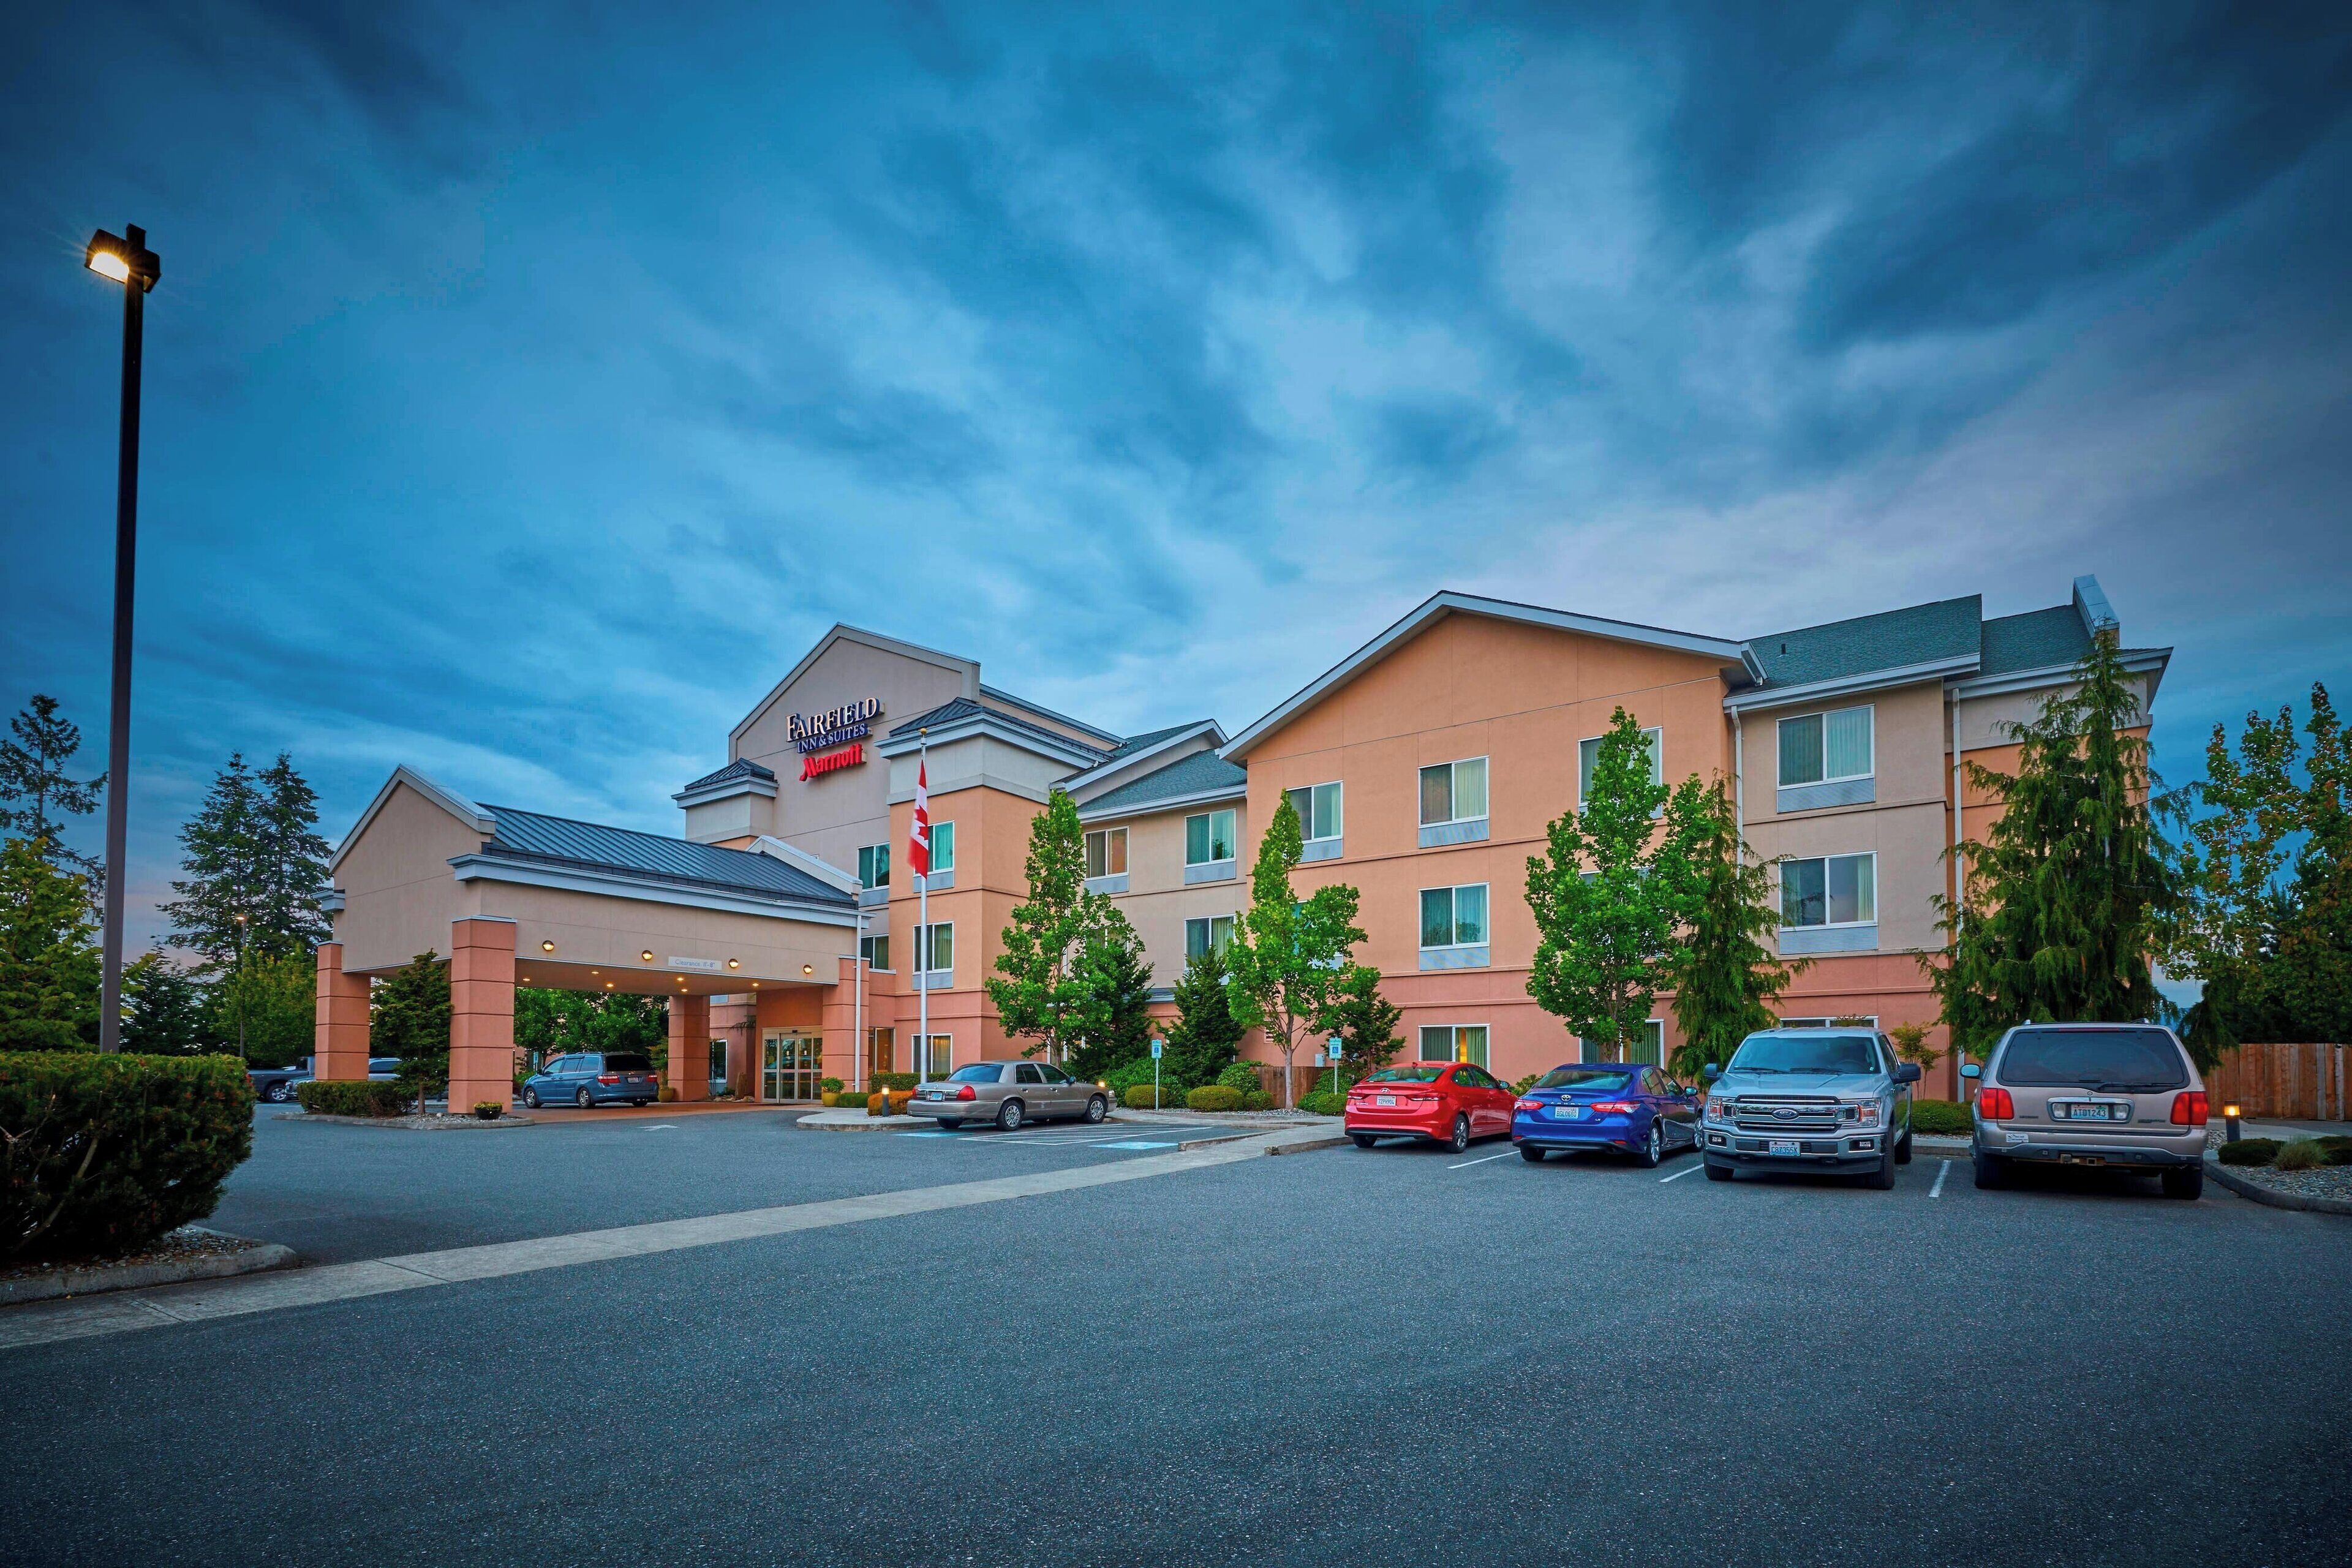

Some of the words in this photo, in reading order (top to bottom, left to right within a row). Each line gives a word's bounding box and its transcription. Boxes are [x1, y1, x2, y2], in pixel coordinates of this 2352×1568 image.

[786, 697, 880, 742] FAIRFIELD
[797, 737, 818, 753] INN
[818, 735, 827, 747] &
[828, 723, 869, 744] SUITES
[799, 744, 864, 781] Marriott
